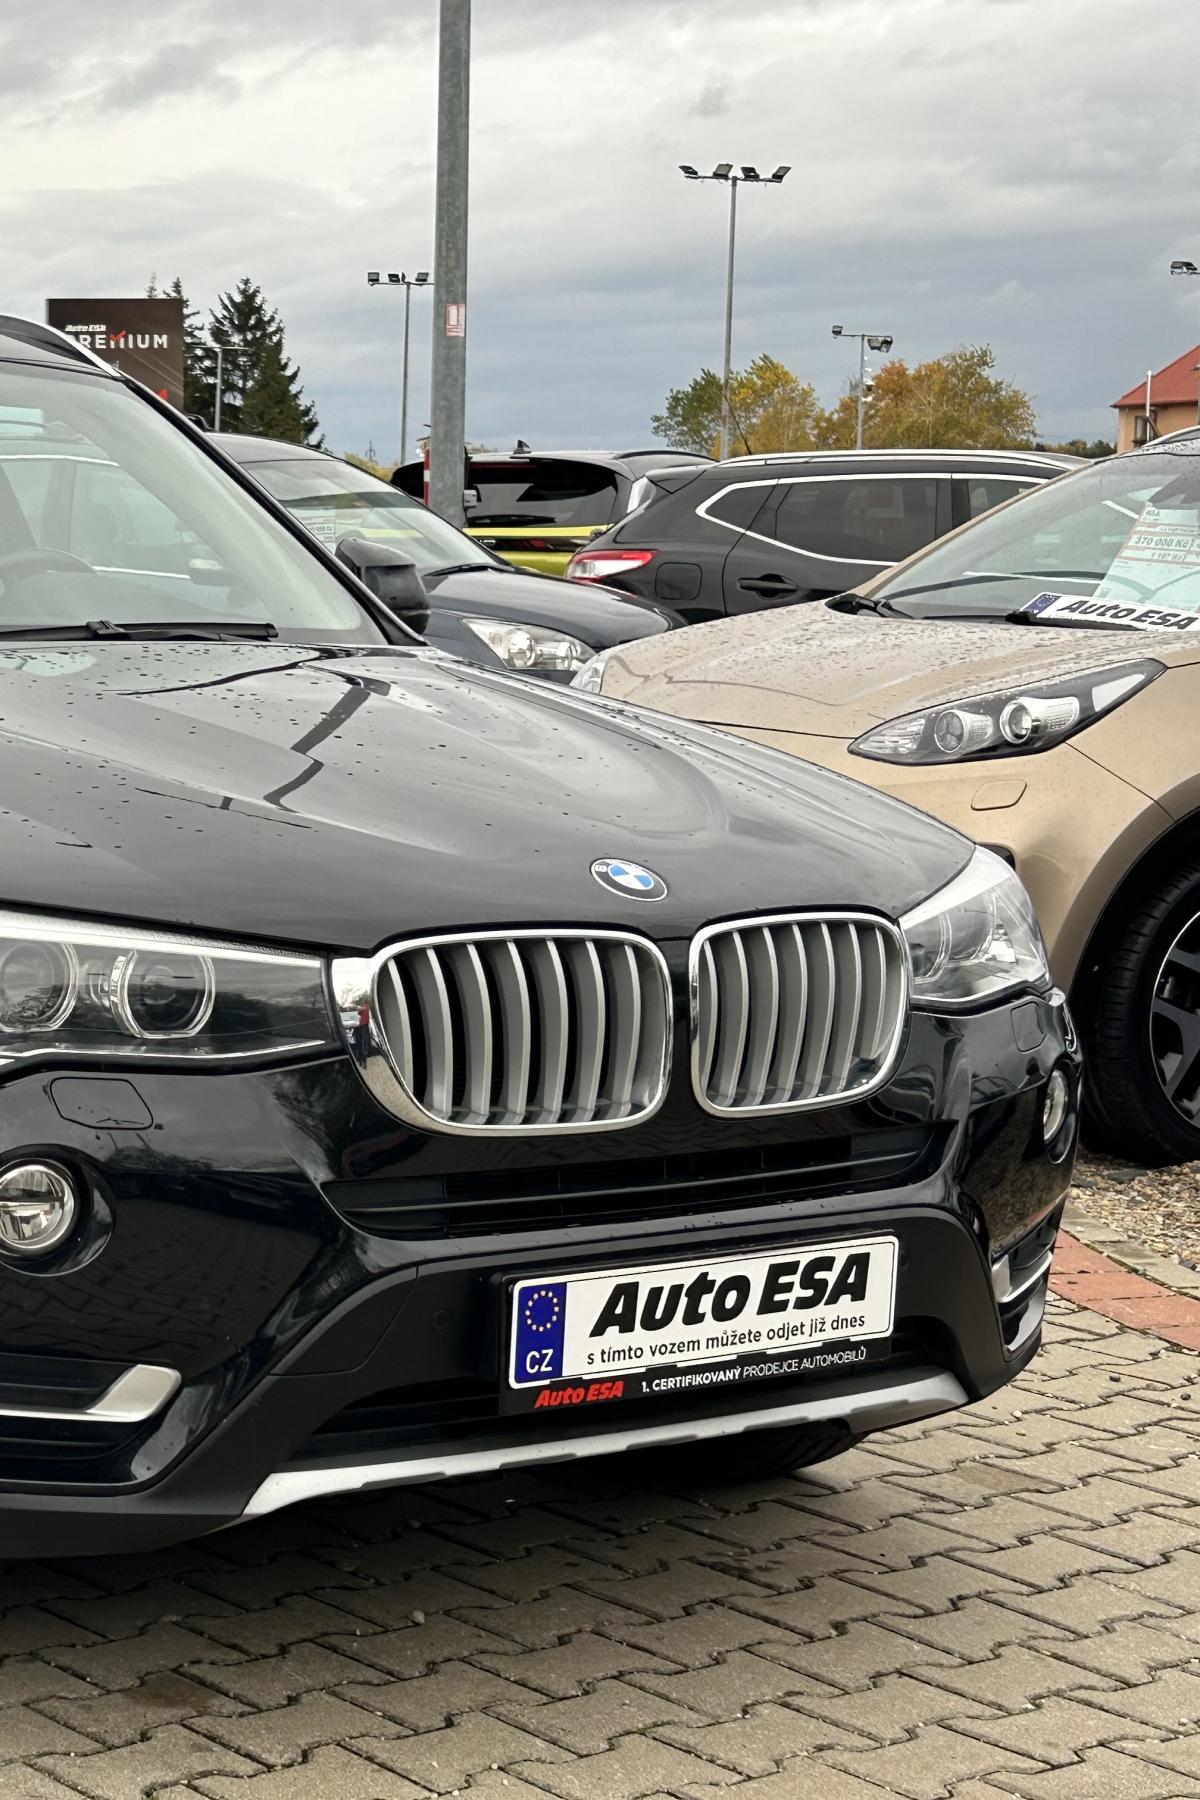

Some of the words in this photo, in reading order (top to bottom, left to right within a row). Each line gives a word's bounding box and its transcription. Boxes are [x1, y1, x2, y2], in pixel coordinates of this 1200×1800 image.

[1056, 600, 1136, 619] Auto
[1131, 610, 1199, 630] ESA
[589, 1271, 751, 1338] Auto
[756, 1252, 871, 1316] ESA
[587, 1352, 595, 1365] s
[600, 1345, 644, 1364] tímto
[649, 1338, 701, 1357] vozem
[706, 1329, 762, 1350] můžete
[766, 1321, 806, 1341] odjet
[808, 1316, 826, 1337] již
[830, 1314, 866, 1331] dnes
[525, 1348, 554, 1374] CZ
[652, 1365, 742, 1391] CERTIFIKOVANÝ
[743, 1359, 799, 1379] PRODEJCE
[800, 1345, 867, 1370] AUTOMOBILŮ
[586, 1380, 624, 1402] ESA
